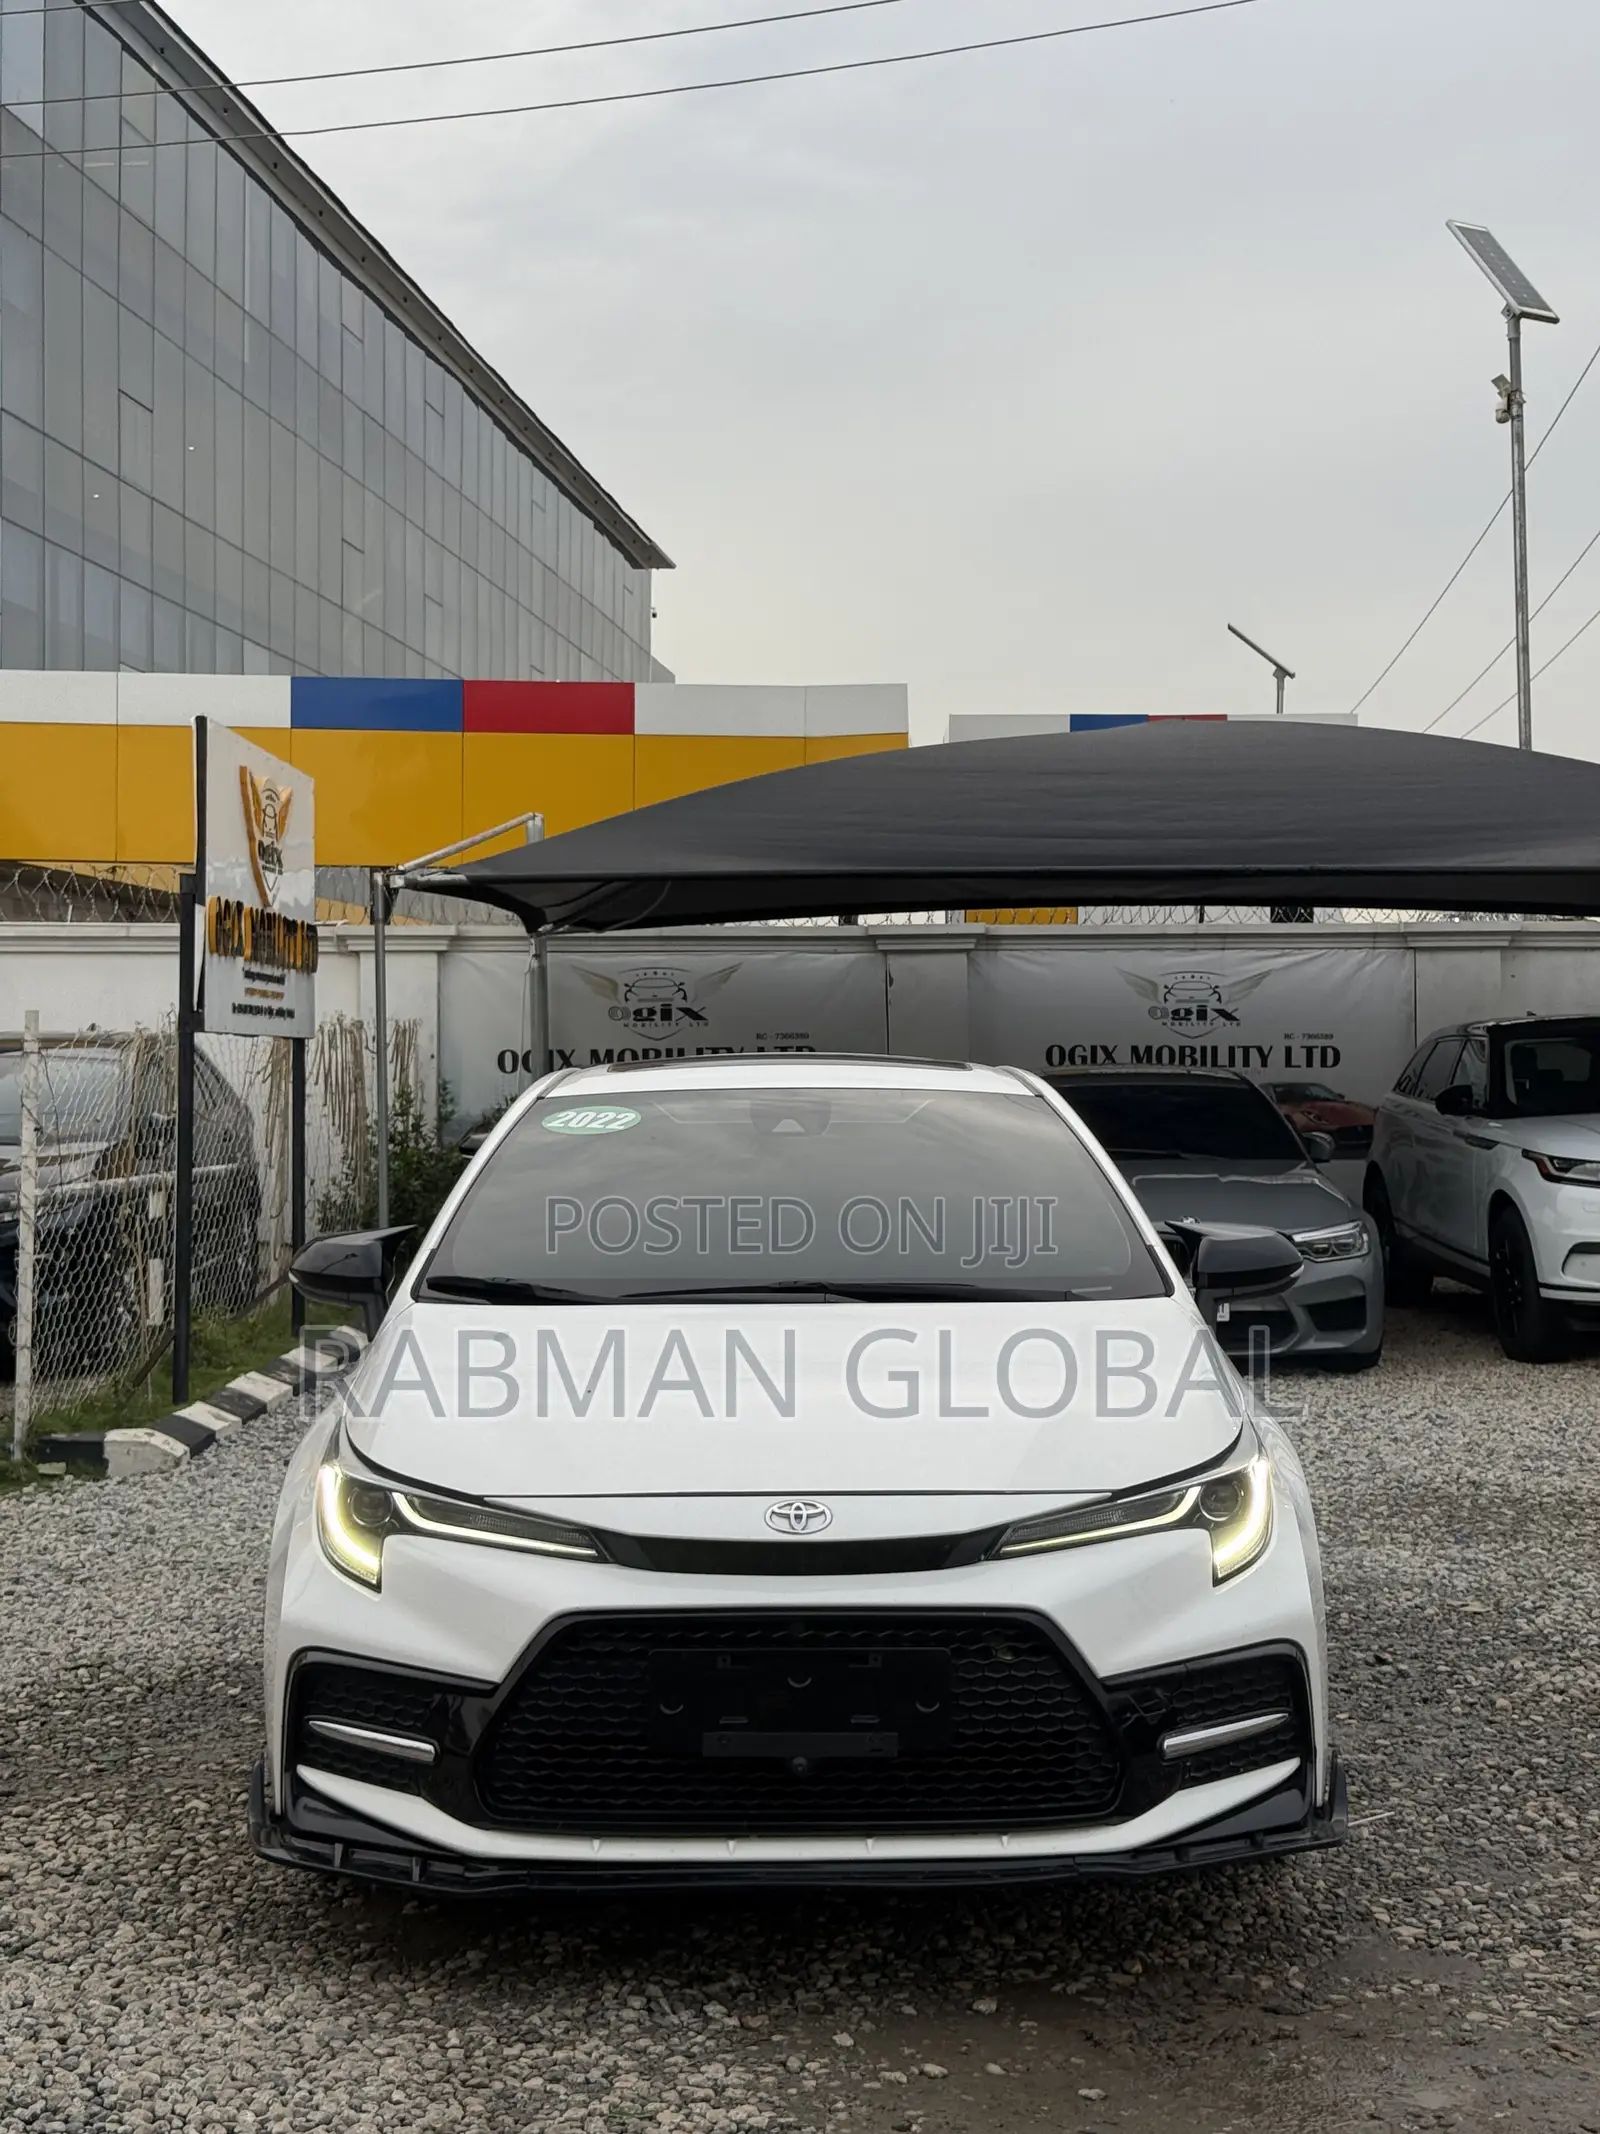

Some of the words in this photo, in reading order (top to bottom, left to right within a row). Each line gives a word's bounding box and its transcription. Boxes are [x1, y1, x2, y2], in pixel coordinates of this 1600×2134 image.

[1045, 1044, 1118, 1067] OGIX
[1130, 1044, 1273, 1068] MOBILITY
[1284, 1045, 1341, 1068] LTD
[546, 1111, 636, 1129] 2022
